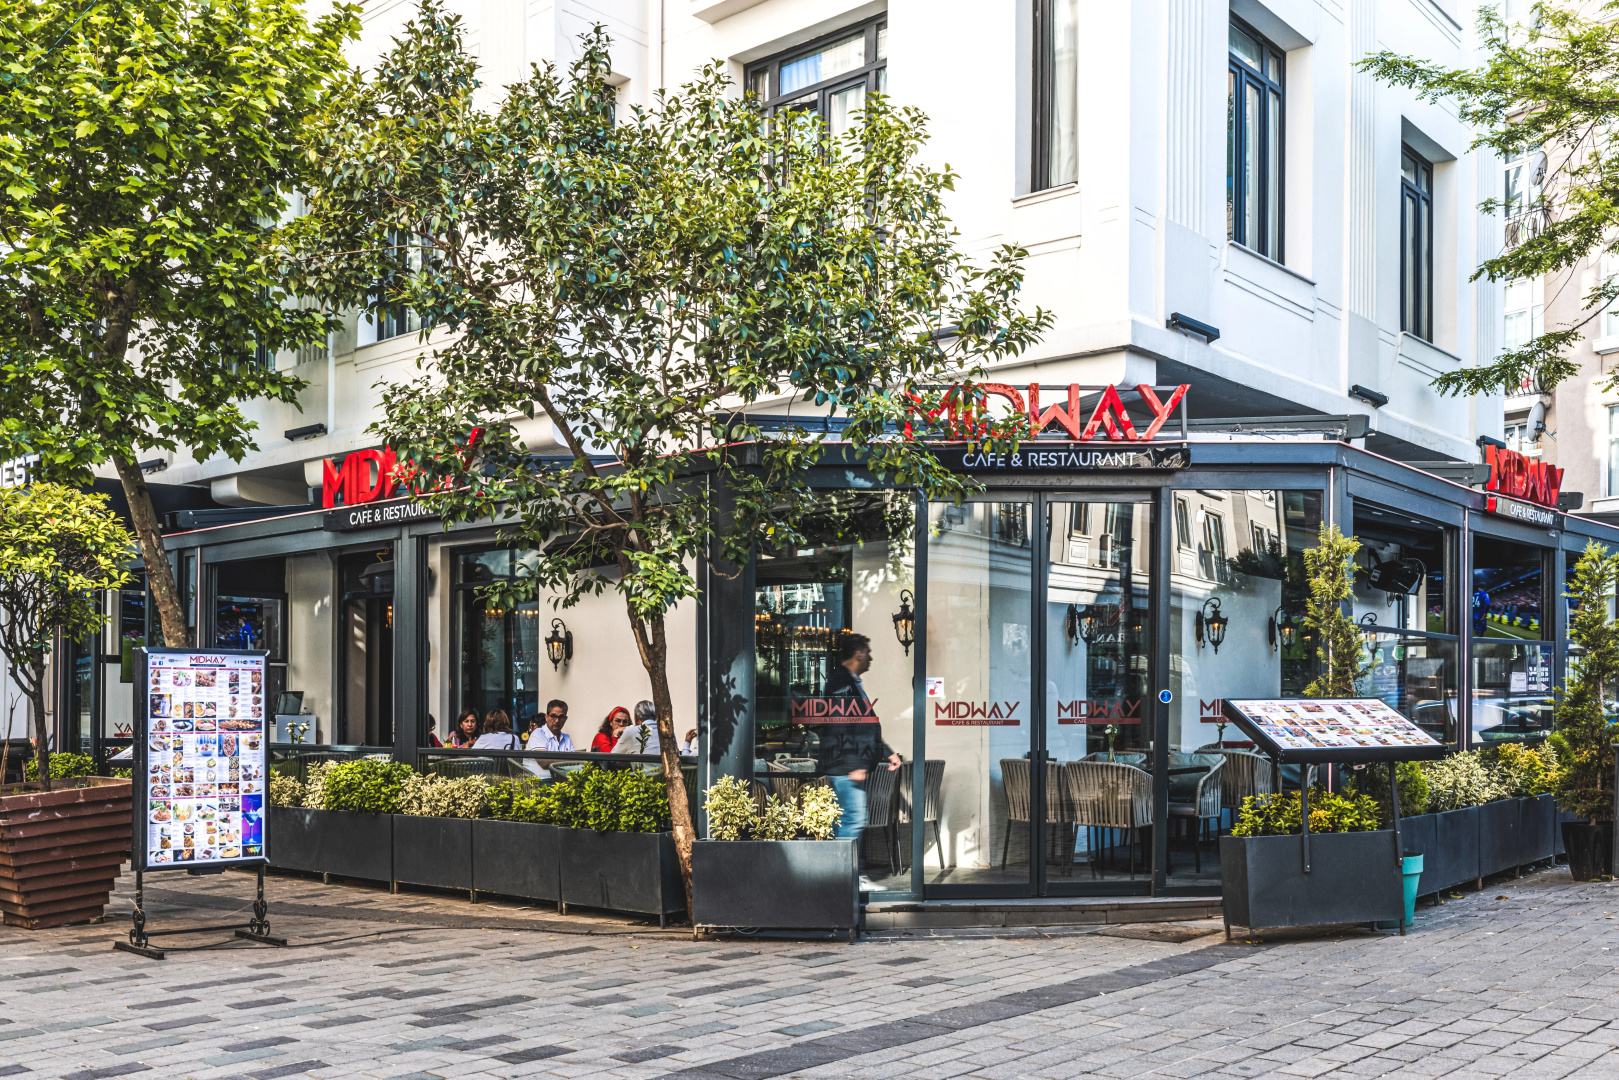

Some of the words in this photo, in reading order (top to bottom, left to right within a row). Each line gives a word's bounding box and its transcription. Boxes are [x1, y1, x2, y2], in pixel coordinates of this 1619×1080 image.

[904, 382, 1191, 441] MIDWAY
[962, 452, 1006, 467] CAFE
[1011, 452, 1023, 467] &
[1028, 452, 1137, 467] RESTAURANT
[0, 454, 39, 489] EST
[1486, 444, 1564, 506] MIDWAY
[349, 510, 373, 525] CAFE
[374, 508, 381, 522] &
[383, 501, 437, 521] RESTAUR
[1510, 503, 1522, 517] CAFE
[1526, 508, 1554, 525] RESTAURANT
[189, 655, 227, 664] MIDWAY
[791, 698, 879, 717] MIDWAY
[935, 701, 1020, 719] MIDWAY
[1058, 699, 1141, 717] MIDWAY
